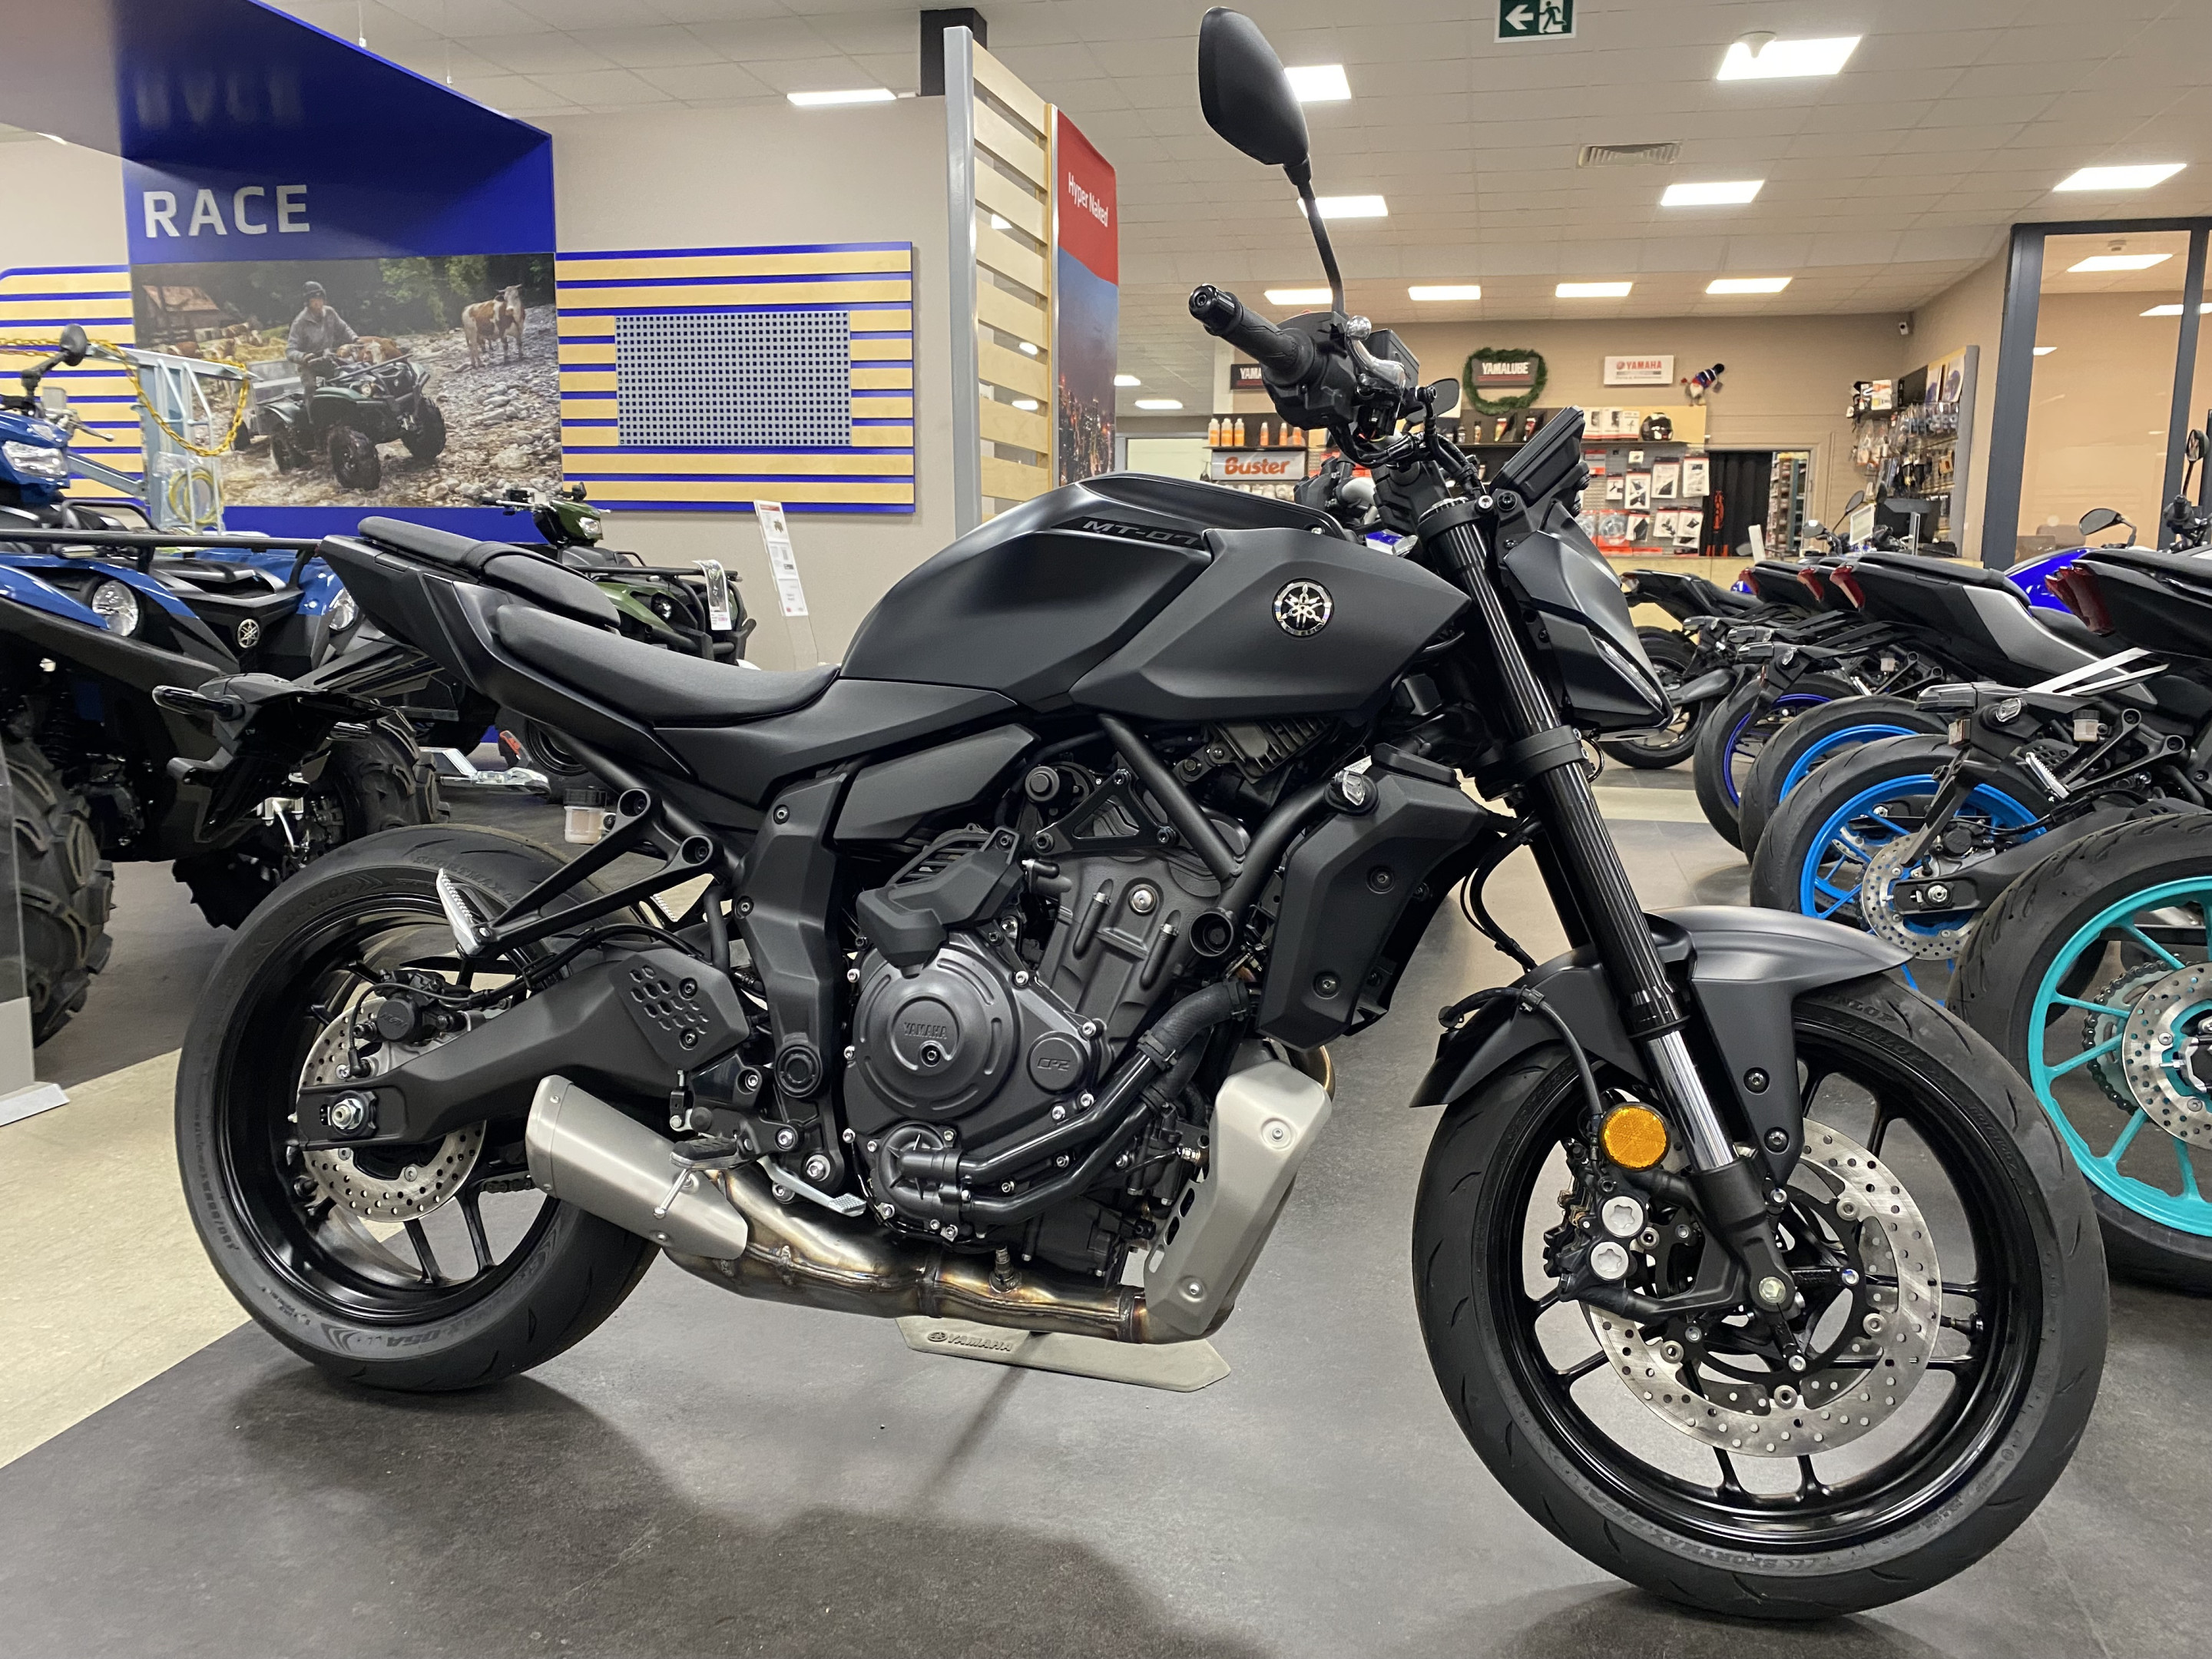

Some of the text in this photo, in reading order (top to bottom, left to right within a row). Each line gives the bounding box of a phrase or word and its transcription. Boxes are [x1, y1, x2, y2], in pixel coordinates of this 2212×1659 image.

[1068, 171, 1108, 227] Hyper Naked
[144, 184, 310, 239] RACE
[1482, 362, 1529, 375] YAMALUBE
[1626, 360, 1662, 369] YAMAHA
[1224, 456, 1291, 475] Buster
[1082, 520, 1197, 545] MT-07
[902, 1022, 948, 1039] YAMAHA
[1036, 1057, 1071, 1072] CP2
[947, 1332, 1013, 1352] YAMAHA
